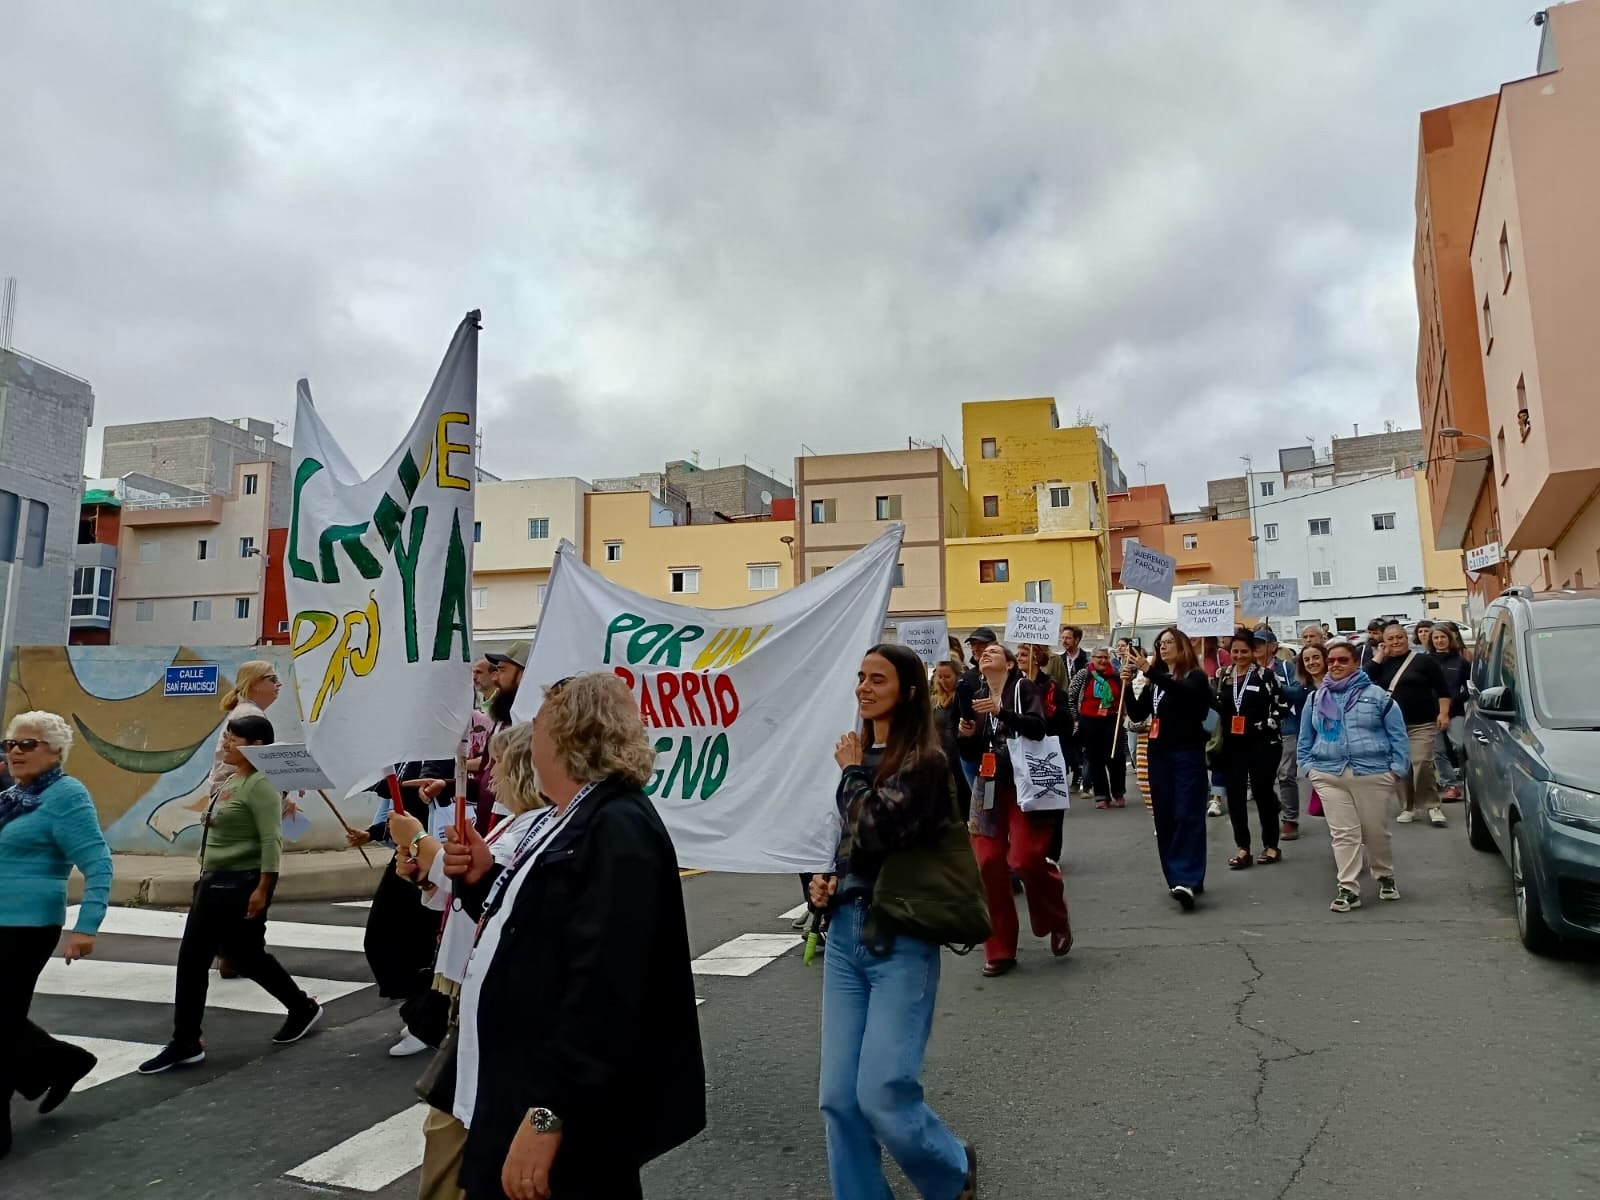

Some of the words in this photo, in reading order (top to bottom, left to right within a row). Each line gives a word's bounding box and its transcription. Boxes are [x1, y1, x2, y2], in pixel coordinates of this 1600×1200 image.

[1471, 548, 1484, 558] BAR
[1133, 550, 1169, 568] QUEREMOS
[1182, 599, 1230, 608] CONCEJALES
[1015, 606, 1054, 615] QUEREMOS
[1018, 623, 1037, 631] PARA
[1013, 631, 1050, 640] JUVENTUD
[603, 613, 704, 667] POR
[692, 624, 773, 670] UN
[179, 669, 204, 679] CALLE
[166, 681, 180, 692] SAN
[180, 681, 216, 692] FRANCISCO
[645, 732, 729, 800] GNO
